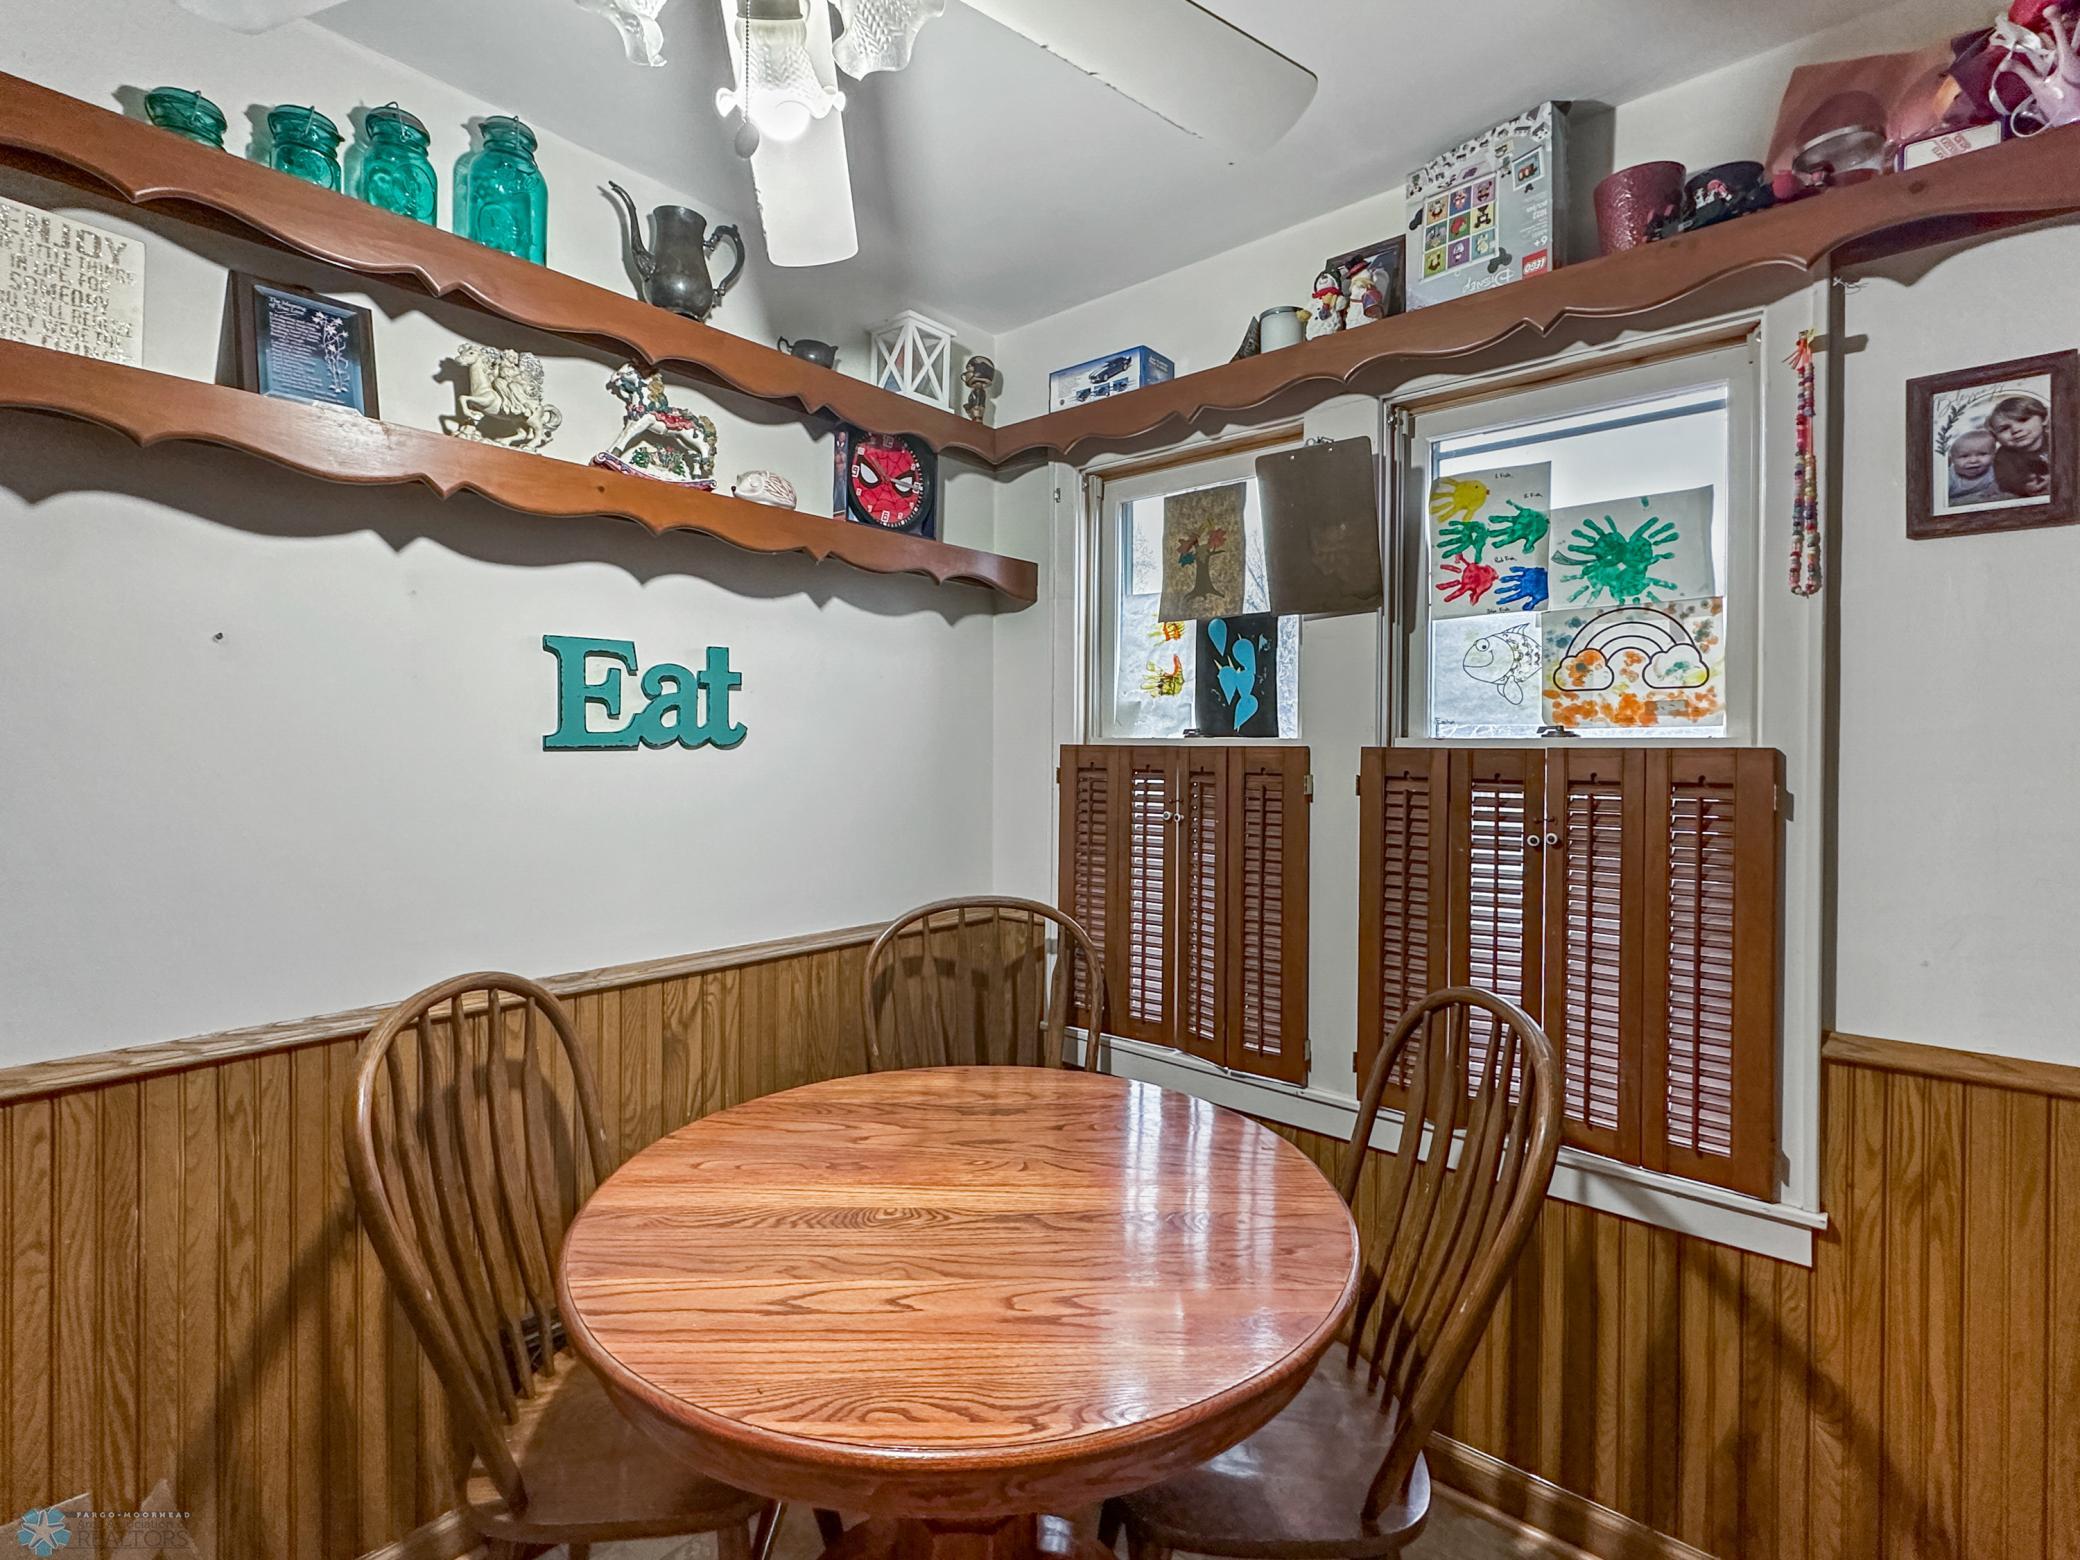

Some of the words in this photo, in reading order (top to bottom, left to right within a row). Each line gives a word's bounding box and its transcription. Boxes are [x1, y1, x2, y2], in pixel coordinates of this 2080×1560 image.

[0, 204, 127, 265] ENJOY
[20, 238, 72, 268] LITTLE
[1523, 256, 1547, 274] LEGO
[79, 272, 111, 294] FOR
[542, 634, 748, 752] Eat
